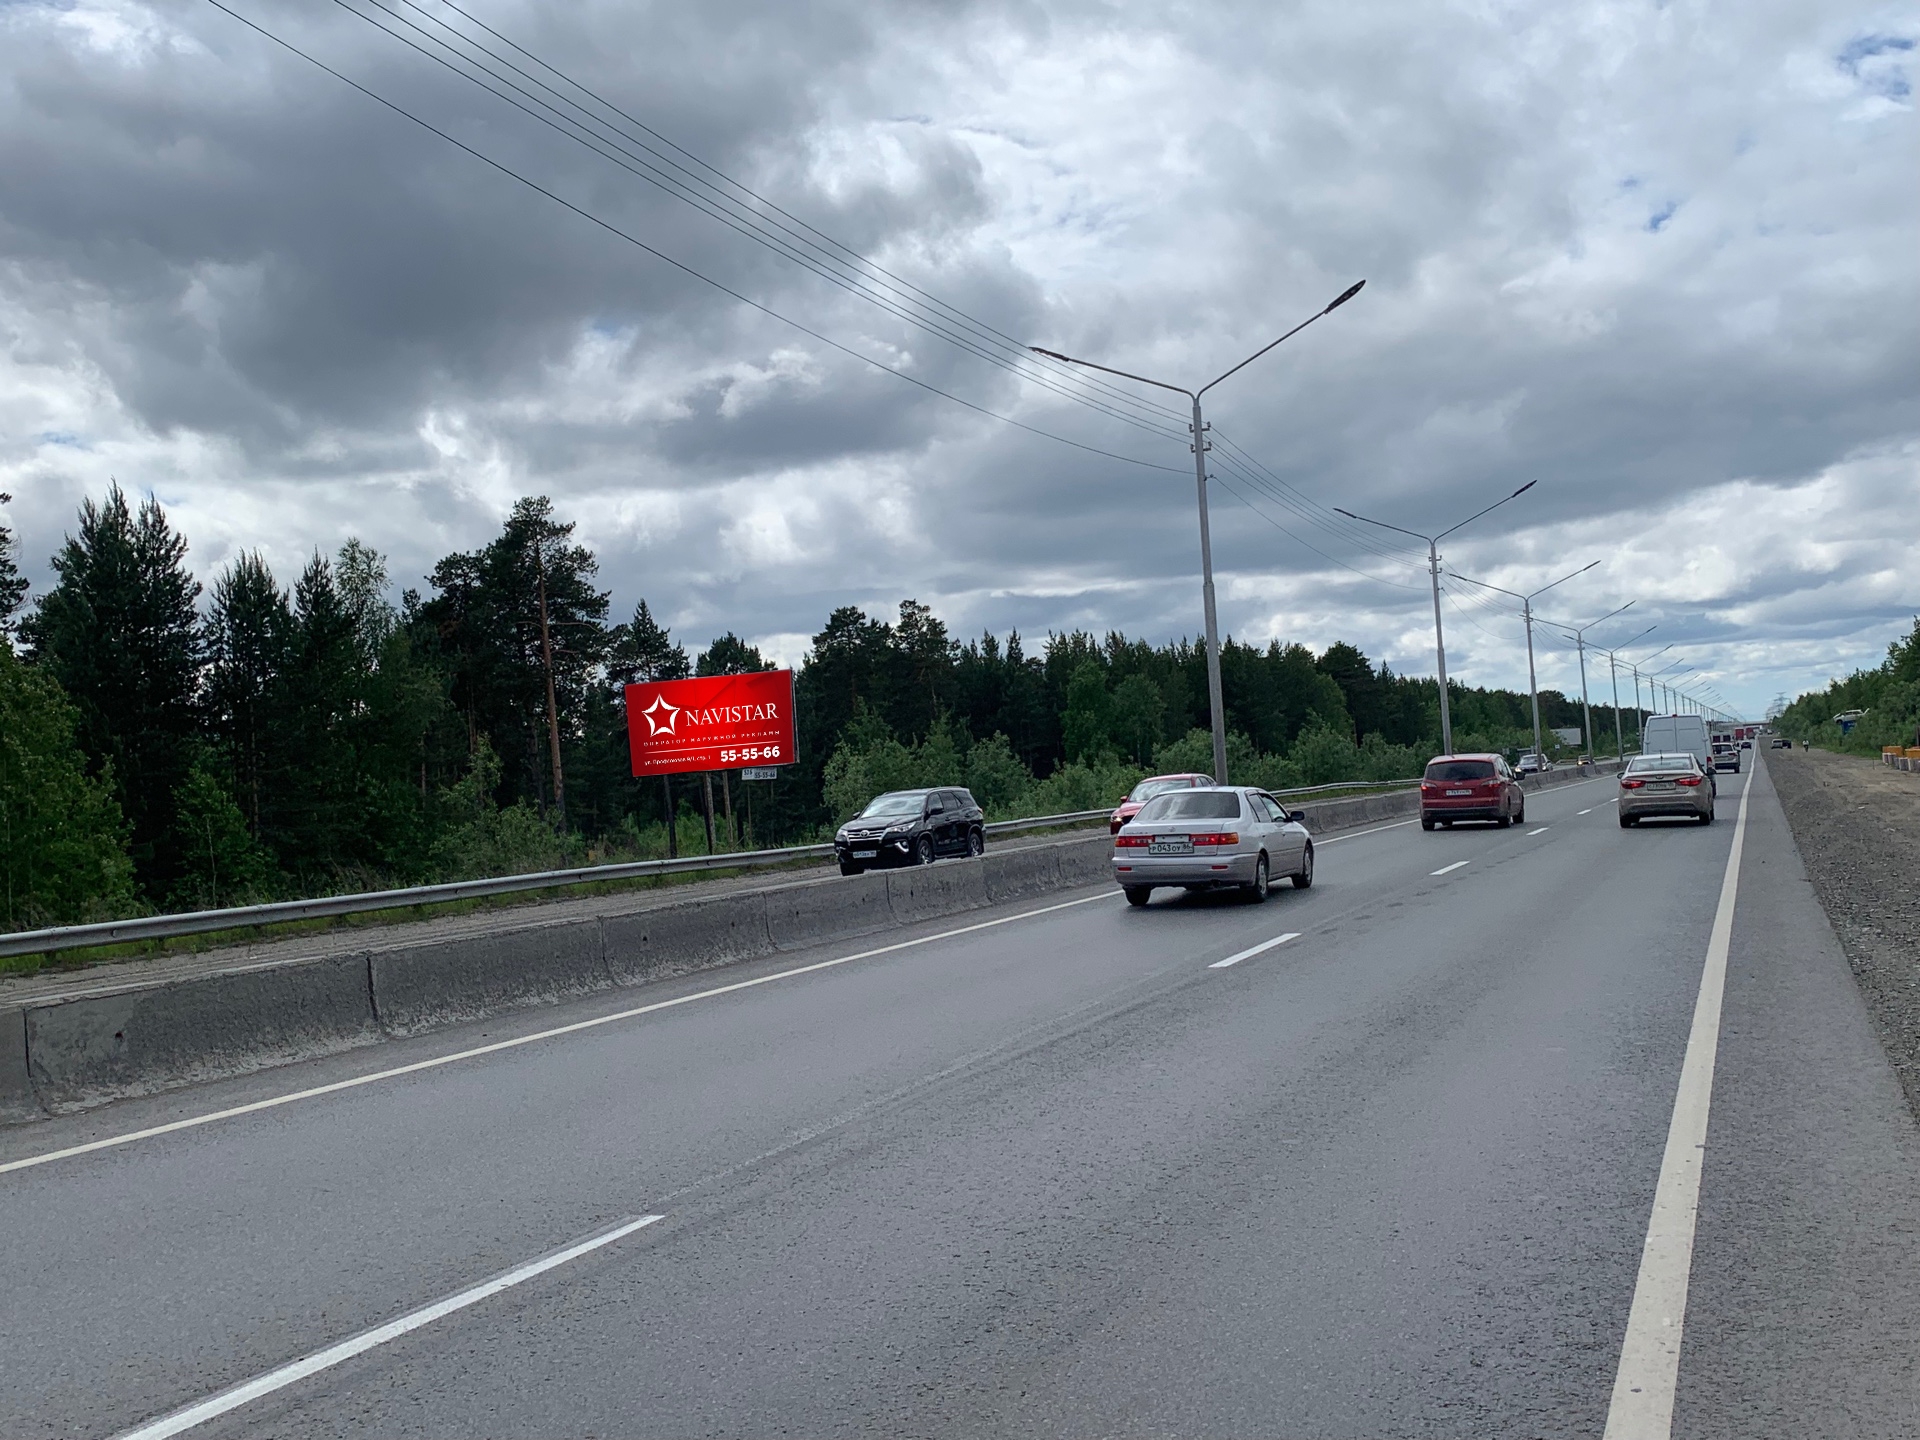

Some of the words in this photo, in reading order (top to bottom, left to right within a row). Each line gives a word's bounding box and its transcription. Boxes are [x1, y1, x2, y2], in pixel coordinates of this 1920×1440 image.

[685, 702, 779, 727] NAVISTAR
[643, 738, 686, 747] ОПЕРАТОР
[690, 733, 737, 743] НАРУЖНОЙ
[741, 730, 780, 739] РЕКЛАМЫ
[720, 745, 780, 763] 55-55-66
